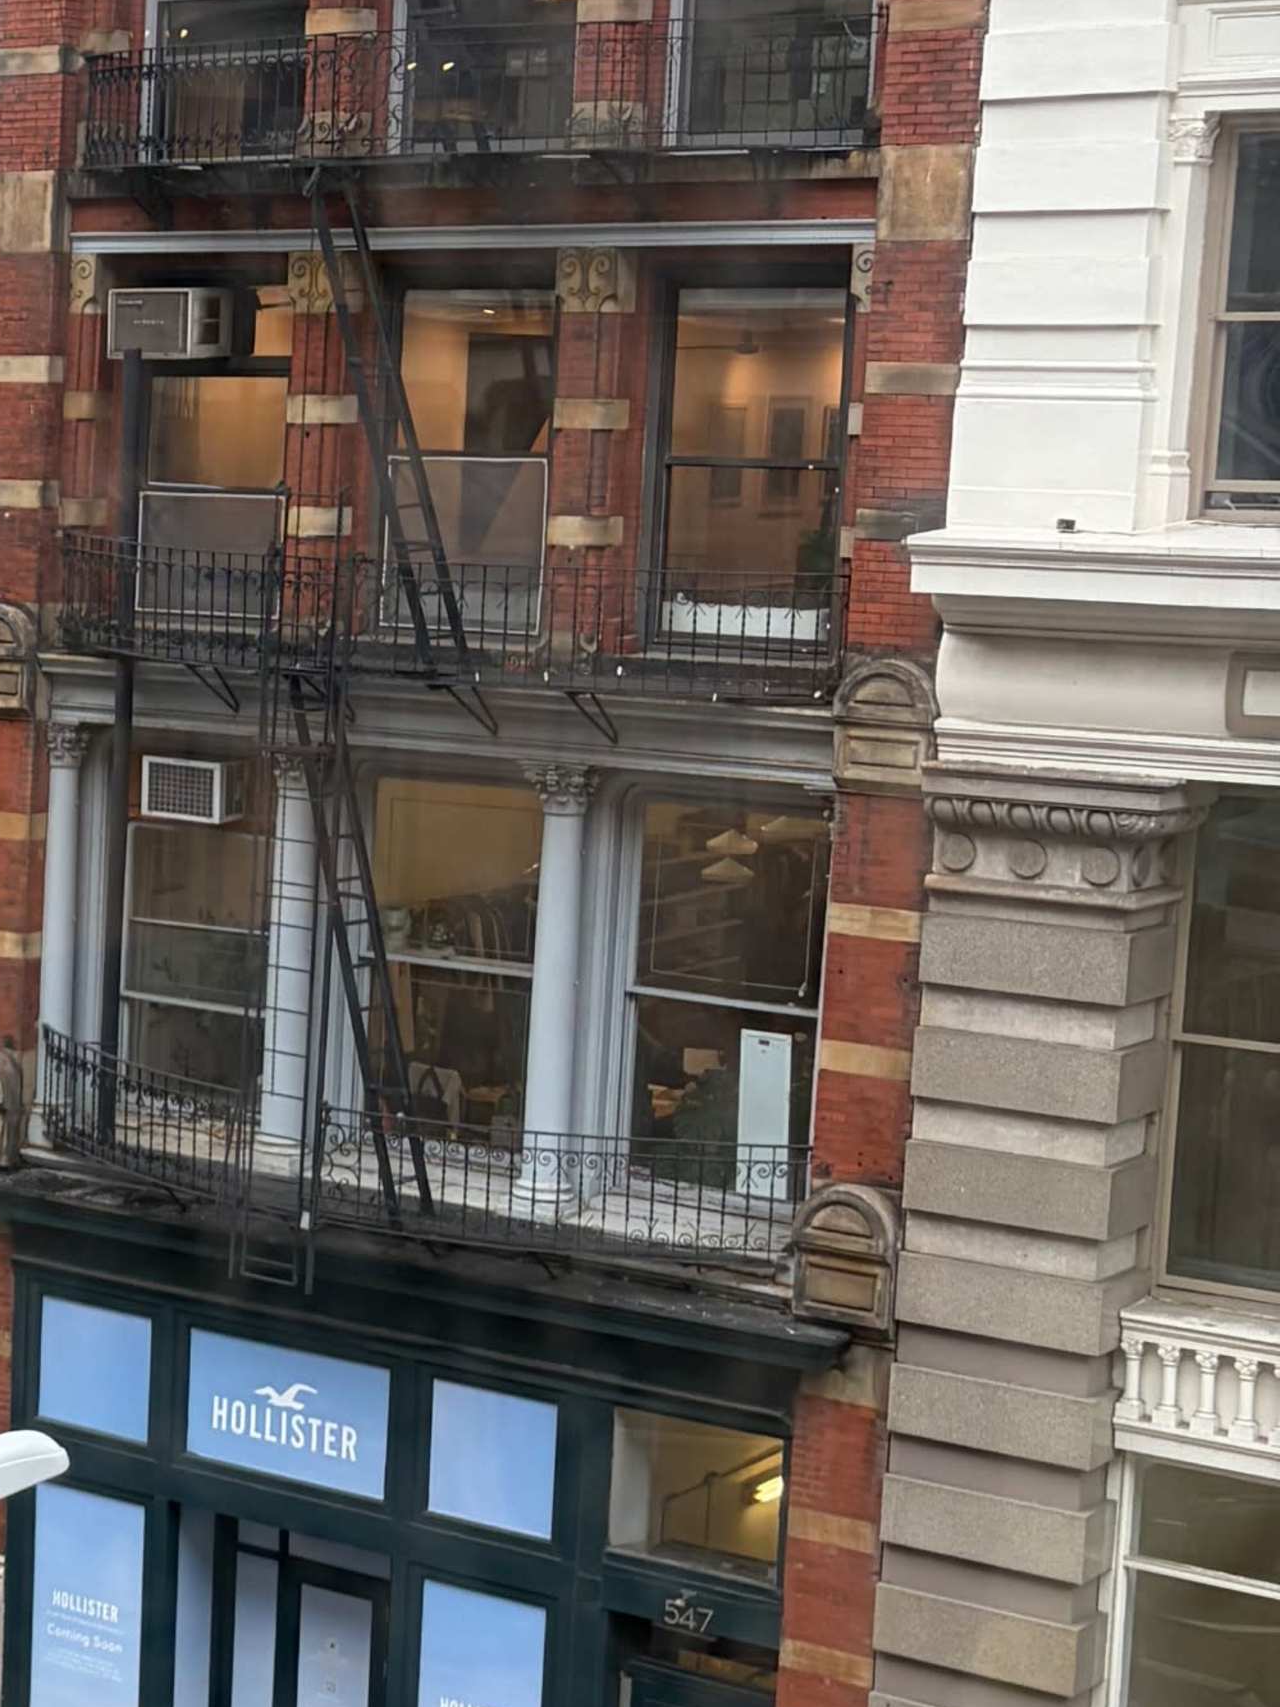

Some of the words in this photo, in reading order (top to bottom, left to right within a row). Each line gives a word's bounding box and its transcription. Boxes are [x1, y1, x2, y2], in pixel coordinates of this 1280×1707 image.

[212, 1395, 357, 1462] HOLLISTER
[52, 1588, 118, 1623] HOLLISTER
[664, 1599, 714, 1632] 547
[47, 1622, 90, 1647] Coming
[93, 1636, 123, 1653] Soon
